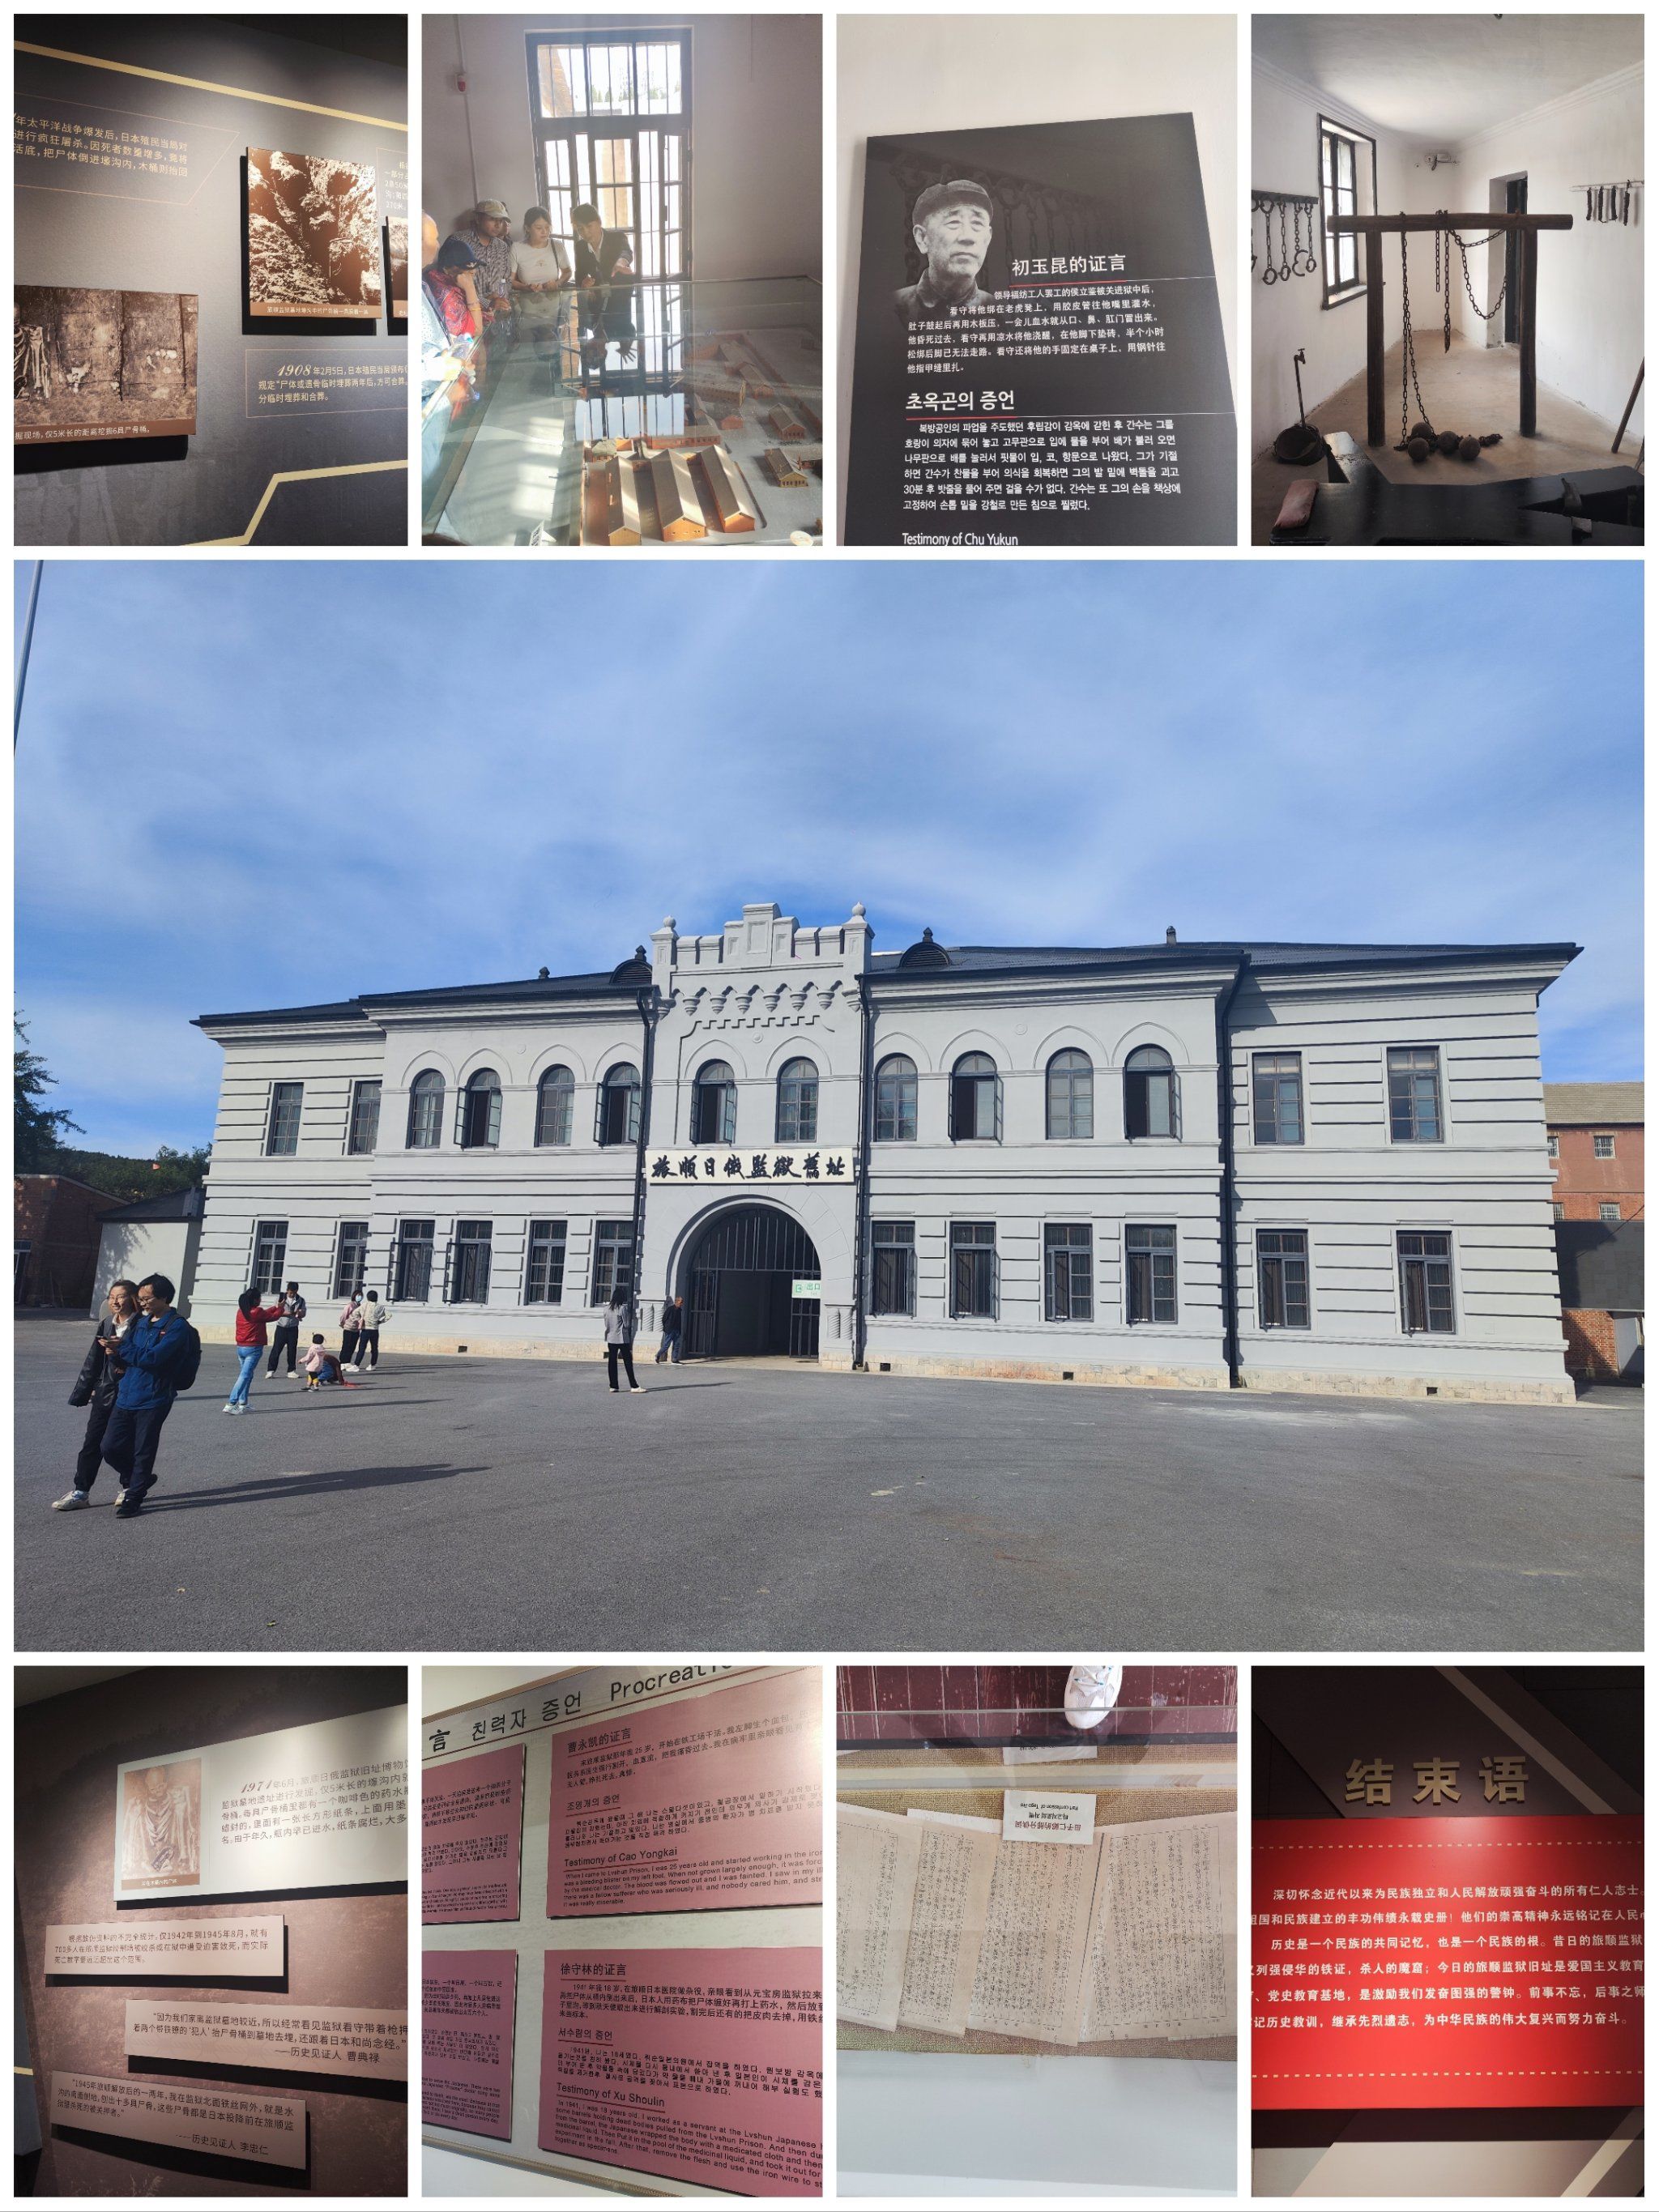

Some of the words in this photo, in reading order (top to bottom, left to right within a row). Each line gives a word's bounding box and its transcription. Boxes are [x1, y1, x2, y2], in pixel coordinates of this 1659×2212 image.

[1012, 254, 1126, 277] 初玉昆的证言
[905, 392, 974, 411] 초옥곤의
[979, 390, 1015, 411] 증언
[962, 422, 987, 432] 파업을
[991, 422, 1023, 432] 주도했던
[1064, 420, 1089, 431] 감옥에
[1114, 420, 1123, 429] 후
[1126, 420, 1152, 429] 간수는
[1156, 419, 1174, 429] 그를
[905, 438, 928, 448] 호랑이
[933, 438, 957, 447] 의자에
[1003, 437, 1045, 446] 고무관으로
[1049, 437, 1066, 446] 입에
[1070, 436, 1087, 446] 물을
[1092, 436, 1109, 445] 부어
[1113, 435, 1131, 445] 배가
[1135, 435, 1153, 445] 불러
[1157, 434, 1175, 445] 오면
[905, 454, 945, 463] 나무판으로
[950, 453, 966, 462] 배를
[970, 453, 996, 462] 눌러서
[1030, 452, 1041, 463] 입,
[1046, 453, 1057, 462] 코,
[1062, 452, 1098, 462] 항문으로
[1102, 451, 1131, 461] 나왔다.
[1136, 450, 1154, 461] 그가
[1159, 450, 1177, 461] 기절
[904, 469, 920, 478] 하면
[925, 468, 949, 478] 간수가
[983, 468, 999, 478] 부어
[1004, 467, 1029, 478] 의식을
[1034, 467, 1068, 478] 회복하면
[1073, 467, 1090, 477] 그의
[1094, 467, 1102, 477] 발
[1107, 467, 1124, 477] 밑에
[904, 484, 923, 494] 30분
[926, 484, 934, 493] 후
[985, 484, 1001, 493] 주면
[1006, 484, 1022, 493] 걸을
[1026, 484, 1043, 493] 수가
[1046, 484, 1065, 493] 없다.
[1069, 484, 1095, 493] 간수는
[1098, 484, 1107, 492] 또
[1111, 483, 1128, 493] 그의
[1132, 483, 1150, 493] 손을
[1154, 483, 1180, 493] 책상에
[903, 500, 936, 510] 고정하여
[940, 500, 956, 509] 손톱
[961, 500, 977, 509] 밑을
[981, 500, 1006, 509] 강철로
[1010, 500, 1027, 509] 만든
[1031, 500, 1056, 509] 침으로
[902, 532, 950, 546] Testimony
[952, 532, 962, 544] of
[964, 533, 985, 545] Chu
[987, 532, 1018, 545] Yukun
[429, 1729, 451, 1753] 言
[471, 1707, 527, 1741] 친력자
[541, 1690, 582, 1723] 증언
[611, 1665, 732, 1702] Procreat
[568, 1728, 631, 1754] 曹永凯的证言
[1345, 1756, 1529, 1806] 结束语
[603, 1793, 620, 1805] 증언
[564, 1856, 605, 1867] Testimony
[608, 1853, 616, 1862] of
[619, 1852, 637, 1861] Cao
[640, 1847, 677, 1860] Yongkai
[561, 1963, 626, 1975] 徐守林的证言
[1251, 1985, 1644, 2001] 、党史教育基地，是激励我们发奋图强的警钟。前事不忘，后事之师
[1251, 2012, 1627, 2028] 记历史教训，继承先烈遗志，为中华民族的伟大复兴而努力奋斗。
[595, 2030, 613, 2041] 증언
[557, 2082, 599, 2099] Testimony
[602, 2091, 611, 2099] of
[613, 2091, 625, 2101] Xu
[629, 2094, 665, 2107] Shoulin
[594, 2114, 614, 2123] holding
[616, 2117, 631, 2125] dead
[633, 2120, 654, 2129] bodies
[656, 2125, 676, 2133] pulled
[678, 2129, 693, 2137] from
[696, 2131, 707, 2139] the
[710, 2133, 736, 2144] Lvshun
[739, 2138, 766, 2150] Prison.
[770, 2144, 785, 2153] And
[788, 2147, 807, 2156] then
[241, 2141, 269, 2156] 李忠仁
